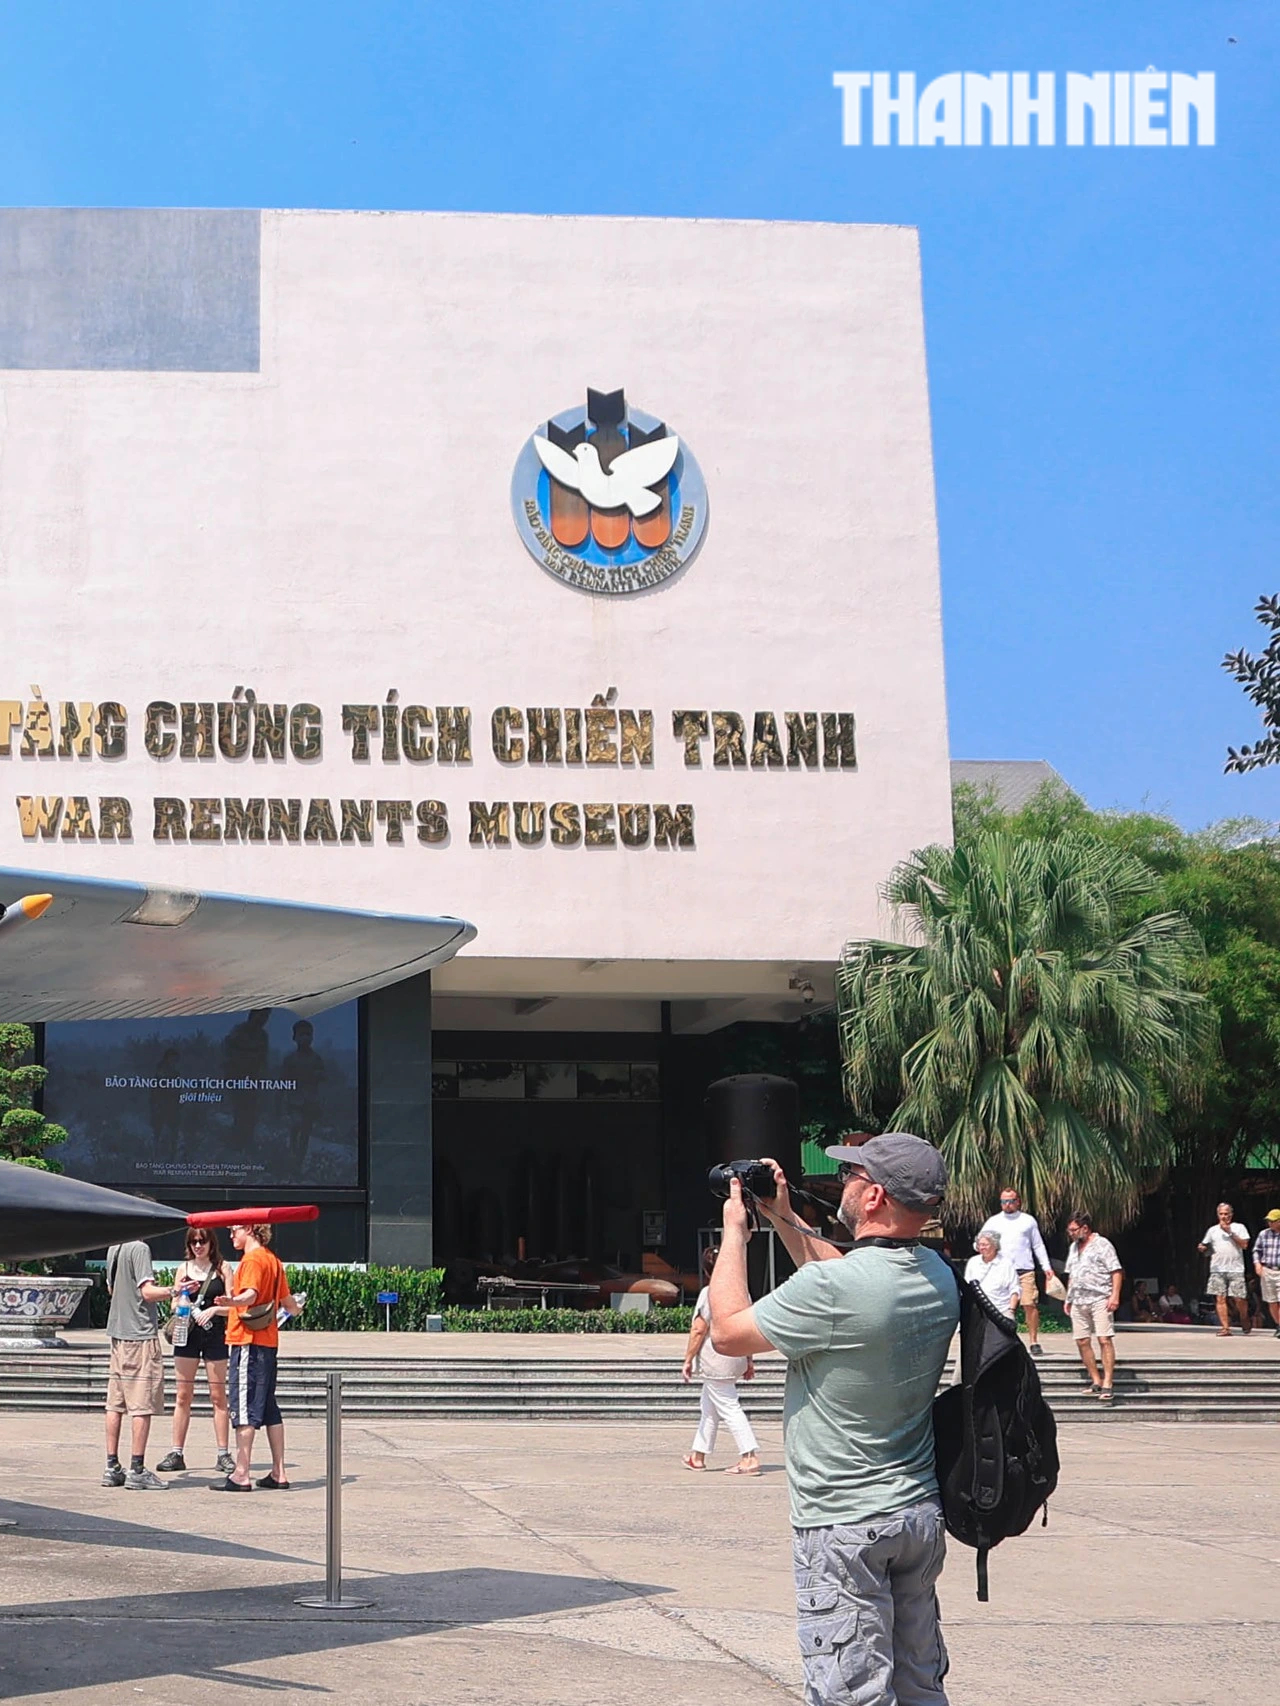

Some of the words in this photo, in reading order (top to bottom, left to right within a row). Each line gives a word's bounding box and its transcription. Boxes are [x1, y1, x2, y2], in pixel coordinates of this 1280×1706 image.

[637, 551, 682, 587] MUSEUM
[144, 686, 322, 759] CHỨNG
[341, 688, 472, 762] TÍCH
[491, 686, 655, 764] CHIẾN
[672, 709, 855, 768] TRANH
[16, 795, 132, 840] WAR
[153, 797, 449, 843] REMNANTS
[469, 801, 696, 847] MUSEUM
[105, 1075, 127, 1088] BẢO
[128, 1076, 158, 1088] TÀNG
[199, 1077, 224, 1089] TÍCH
[260, 1080, 296, 1090] TRANH
